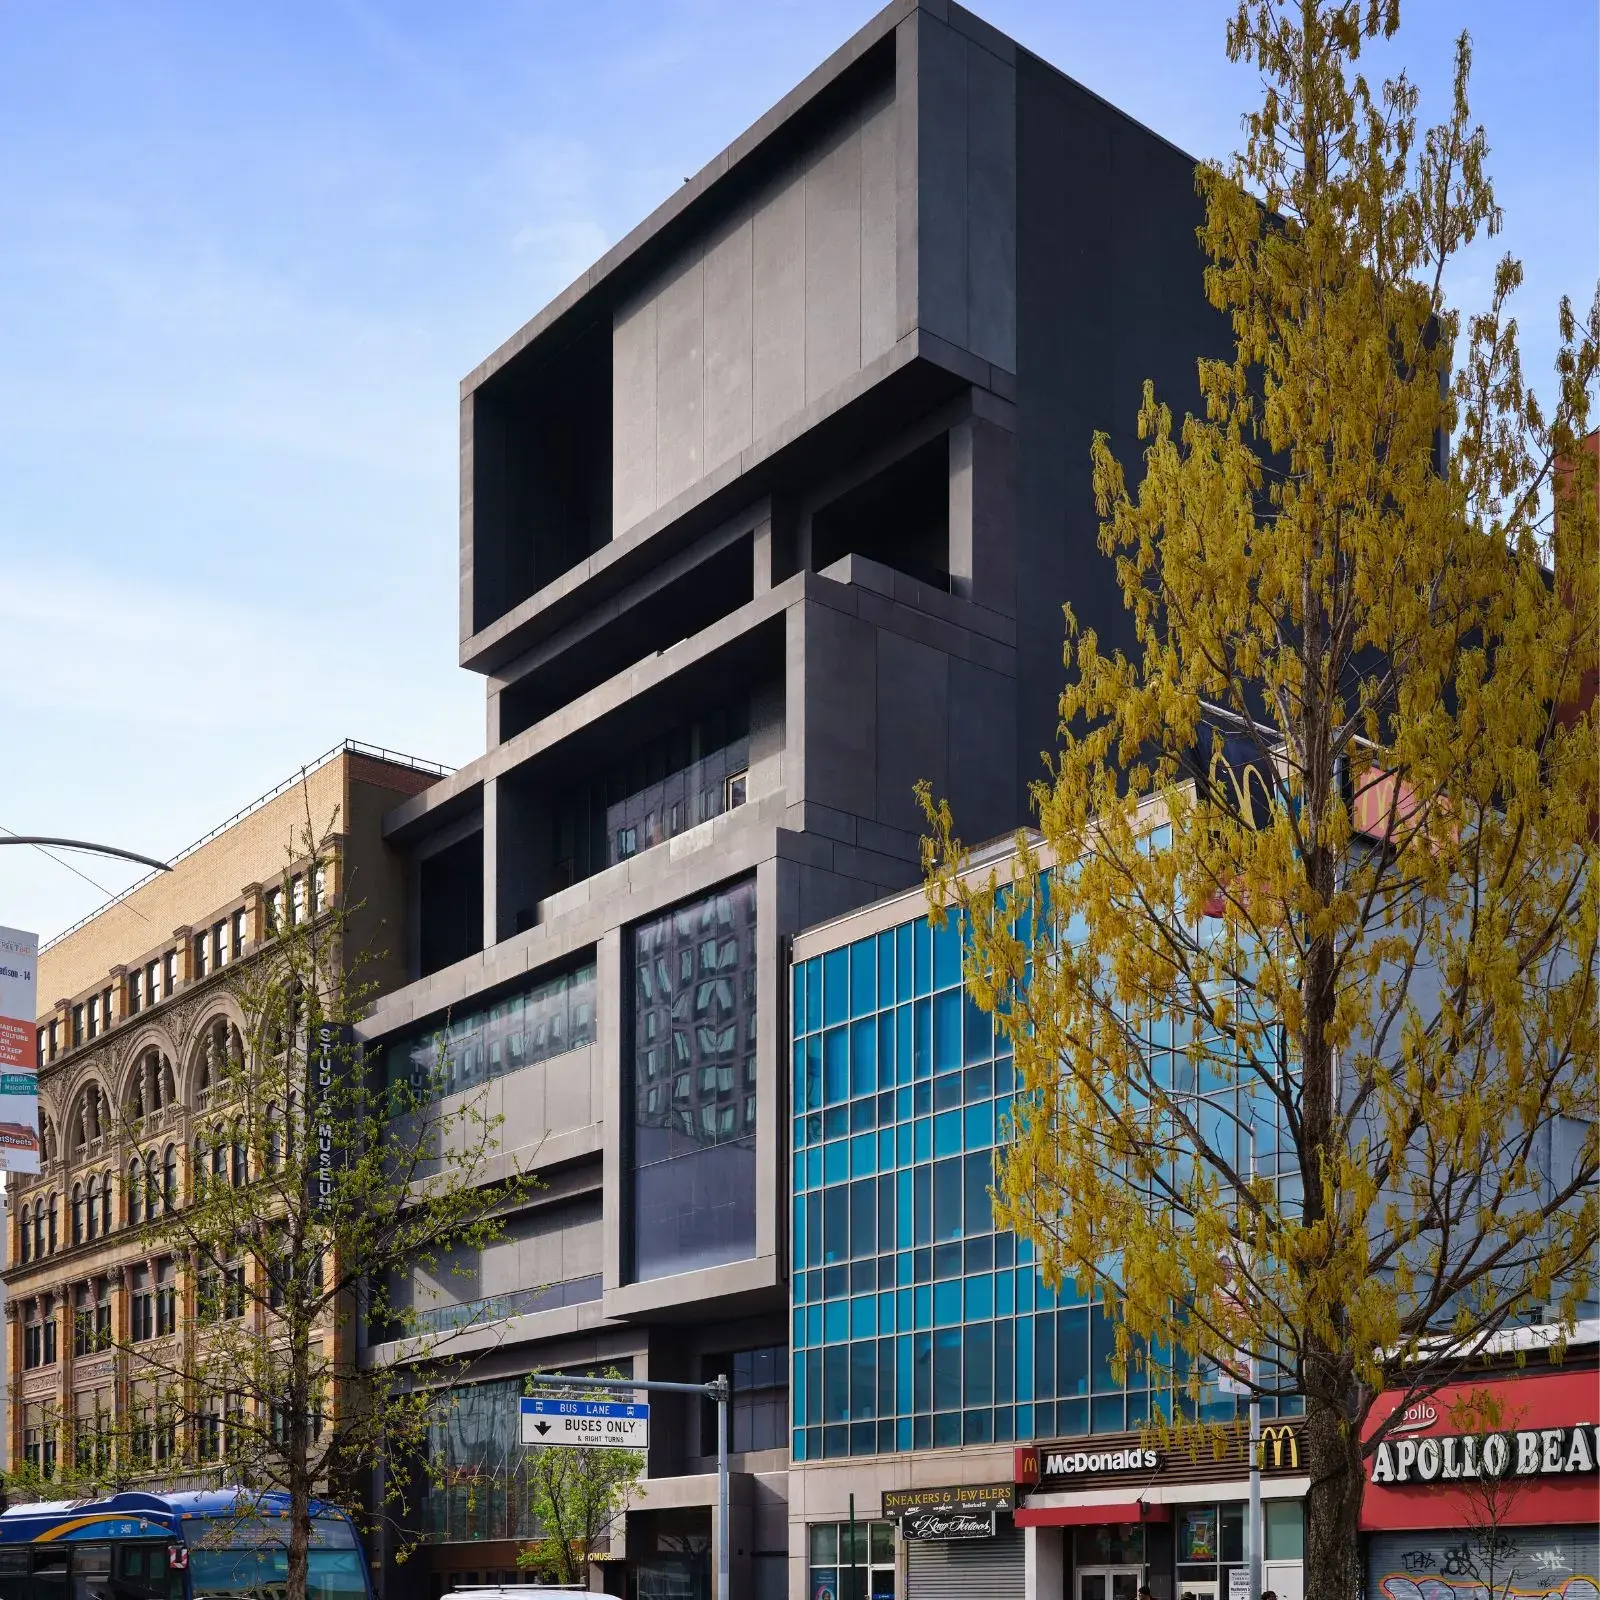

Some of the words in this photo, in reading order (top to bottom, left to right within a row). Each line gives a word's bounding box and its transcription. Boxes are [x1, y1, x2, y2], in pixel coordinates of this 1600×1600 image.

[24, 971, 31, 981] 14
[2, 1031, 29, 1042] CULTURE
[560, 1403, 578, 1413] BUS
[586, 1405, 610, 1415] LANE
[1391, 1404, 1436, 1421] pollo
[565, 1419, 602, 1432] BUSES
[606, 1420, 636, 1433] ONLY
[1045, 1449, 1157, 1475] McDonald's
[1371, 1434, 1510, 1482] APOLLO
[1516, 1427, 1600, 1475] BEA
[886, 1492, 940, 1507] SNEAKERS
[943, 1492, 951, 1502] &
[955, 1487, 1011, 1502] JEWELERS
